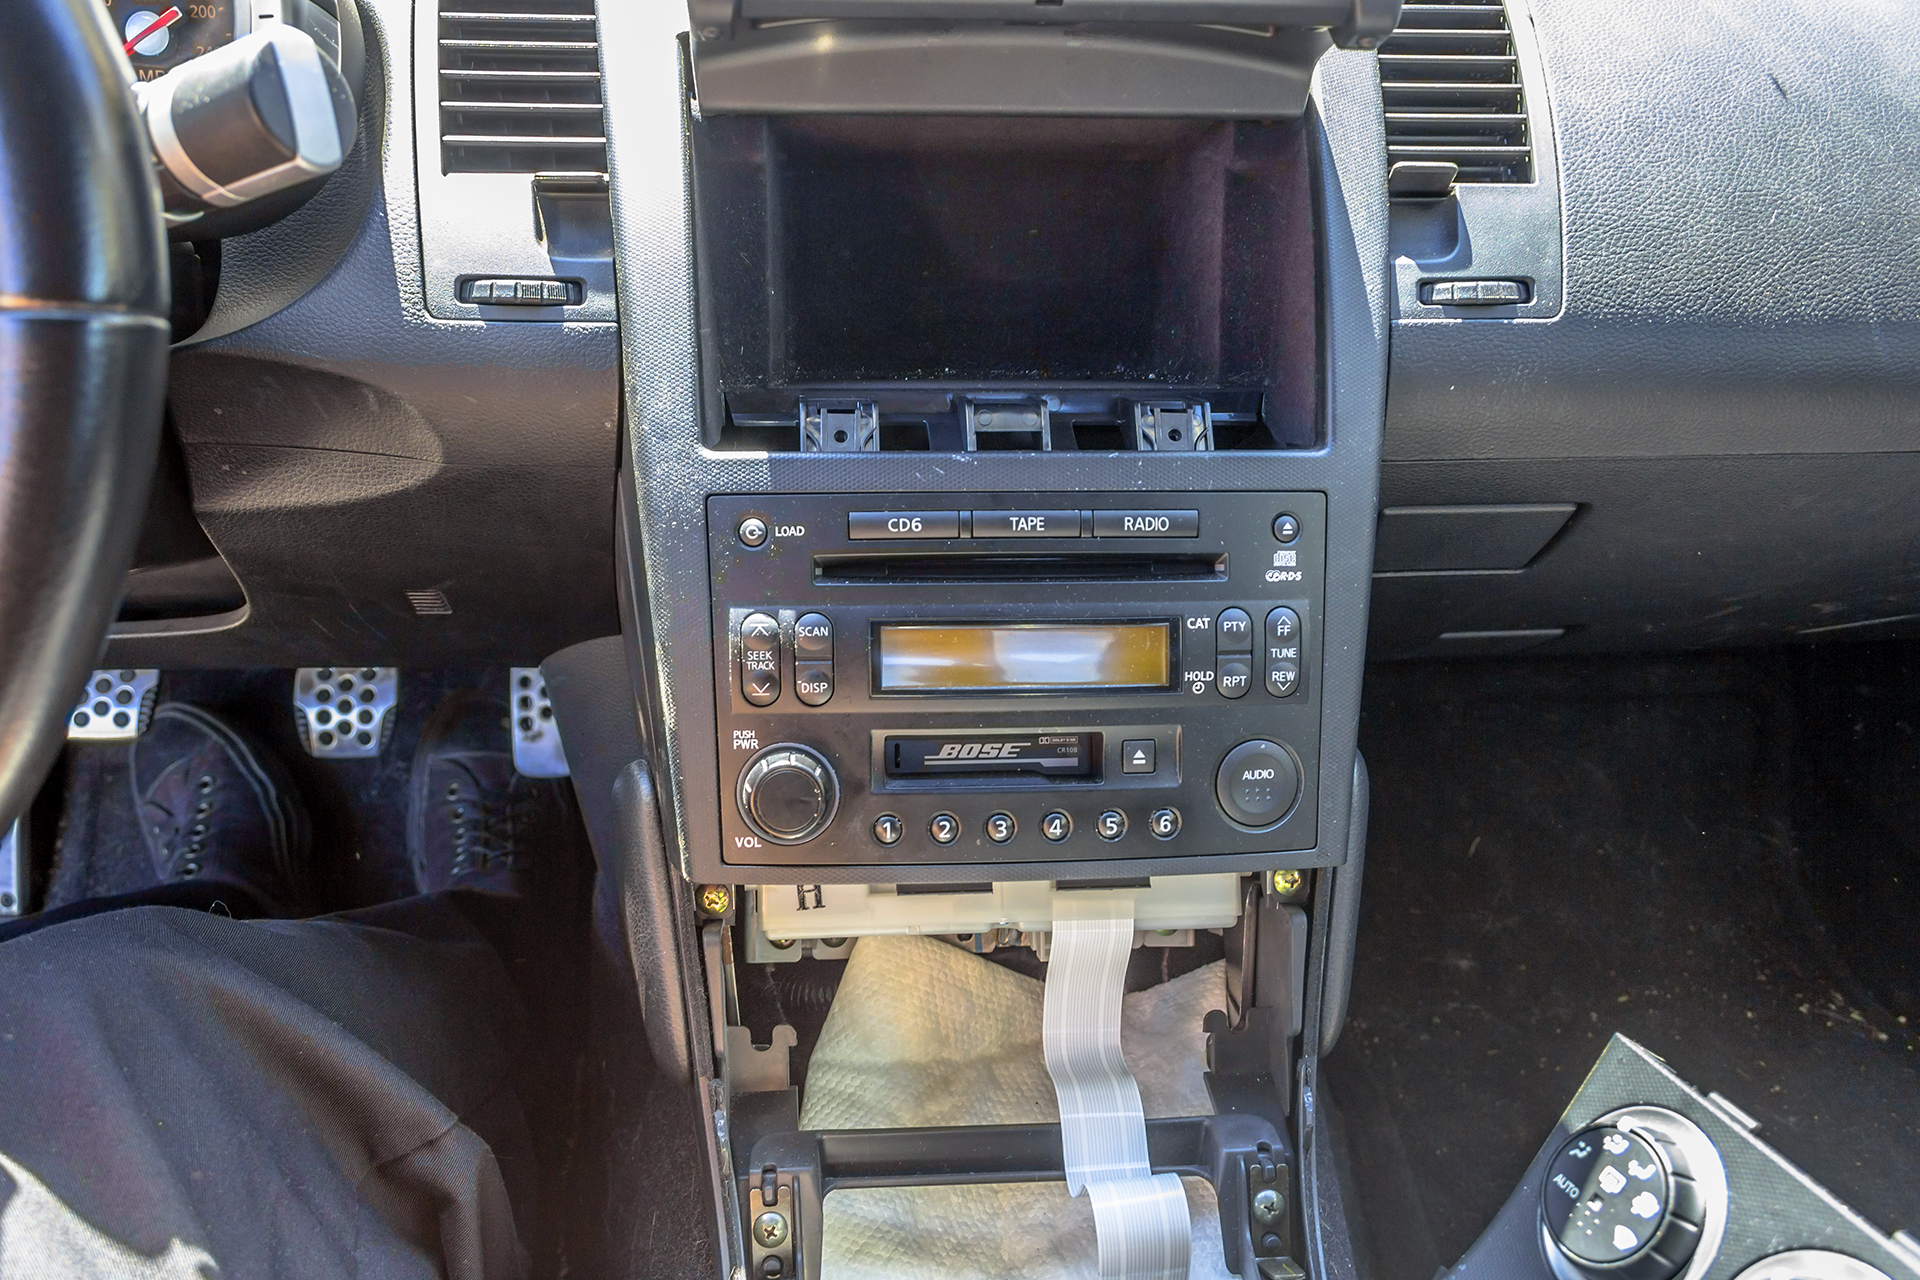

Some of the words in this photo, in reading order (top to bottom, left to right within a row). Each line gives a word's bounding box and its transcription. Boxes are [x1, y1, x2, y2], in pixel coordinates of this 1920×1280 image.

[189, 5, 217, 18] 200
[196, 46, 219, 56] 24
[887, 517, 922, 532] CD6
[1009, 516, 1045, 531] TAPE
[1124, 517, 1169, 531] RADIO
[775, 526, 804, 536] LOAD
[1187, 618, 1210, 630] CAT
[1223, 621, 1246, 632] PTY
[799, 626, 829, 637] SCAN
[1277, 625, 1291, 636] FF
[747, 651, 773, 661] SEEK
[1271, 648, 1297, 658] TUNE
[747, 661, 775, 671] TRACK
[1184, 670, 1215, 682] HOLD
[1223, 676, 1247, 687] RPT
[1272, 671, 1295, 682] REW
[801, 682, 828, 694] DISP
[733, 730, 755, 739] PUSH
[733, 739, 759, 750] PWR
[924, 742, 1032, 759] BOSE
[1242, 769, 1274, 781] AUDIO
[938, 821, 951, 838] 2
[995, 820, 1008, 837] 3
[1049, 819, 1062, 835] 4
[1105, 817, 1118, 834] 5
[1160, 815, 1172, 832] 6
[882, 822, 891, 838] 1
[735, 836, 762, 848] VOL
[1552, 1173, 1580, 1199] AUTO
